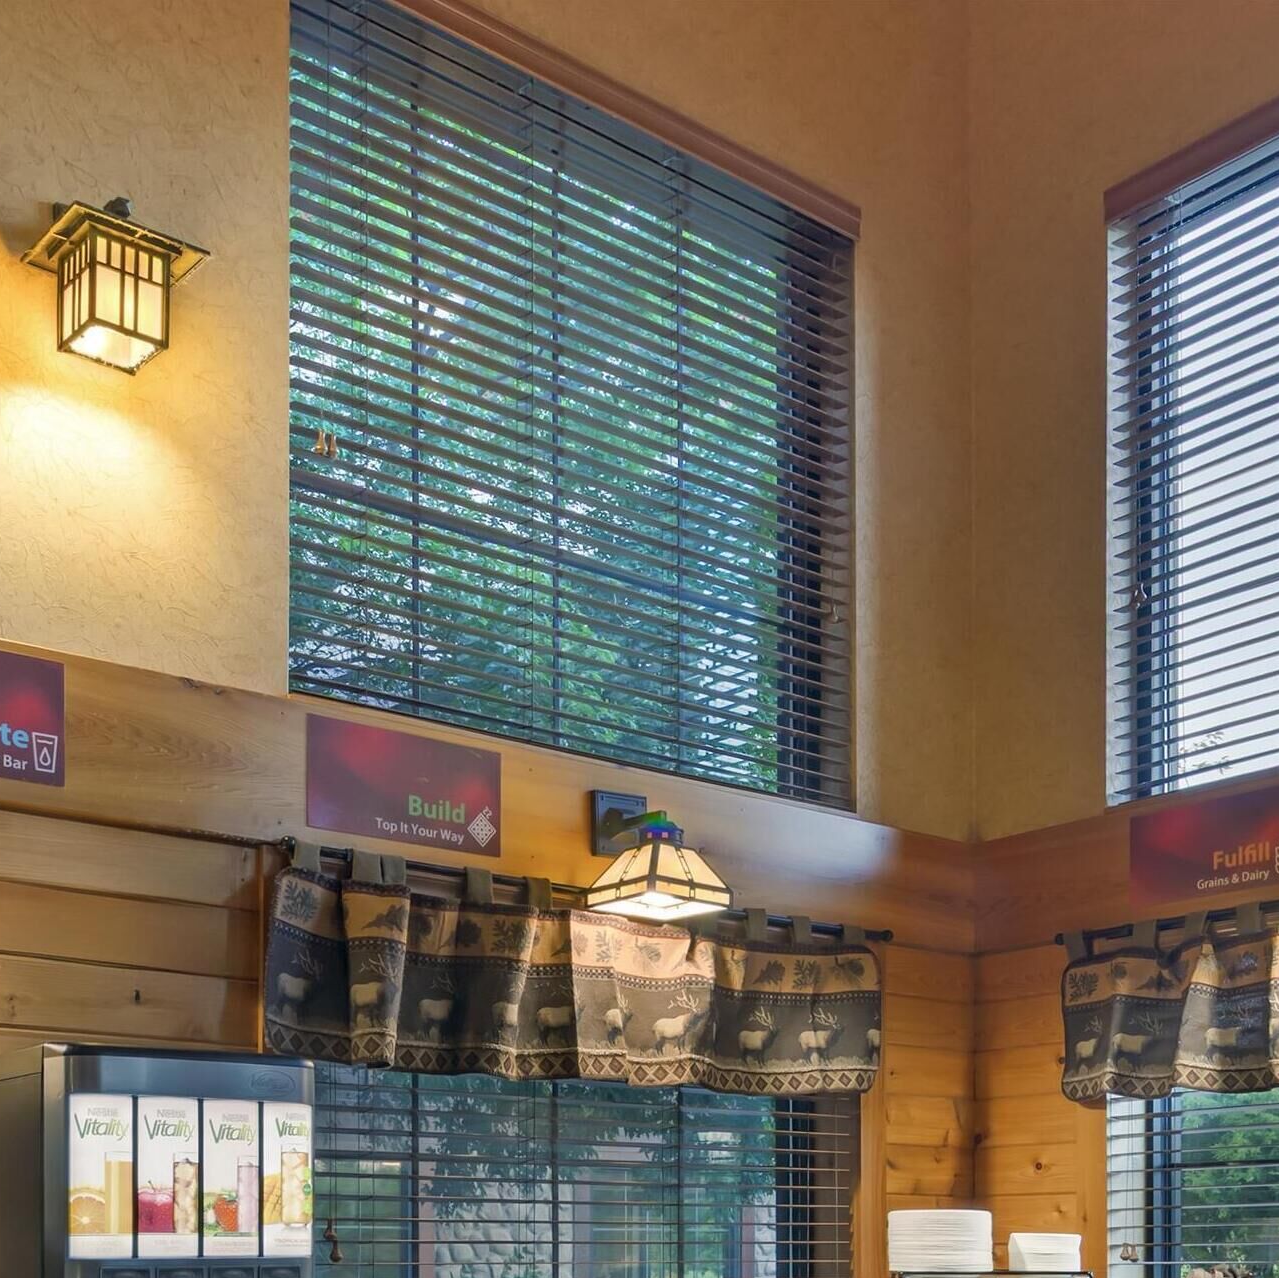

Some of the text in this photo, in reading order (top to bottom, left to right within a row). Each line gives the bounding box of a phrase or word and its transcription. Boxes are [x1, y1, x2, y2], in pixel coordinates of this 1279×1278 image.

[3, 755, 27, 771] Bar
[408, 794, 465, 824] Build
[375, 817, 465, 845] Top It Your Way
[1213, 841, 1270, 870] Fulfill
[1197, 869, 1270, 890] Grains & Dairy
[74, 1113, 130, 1141] Vitality
[144, 1114, 195, 1142] Vitality
[209, 1118, 257, 1146] Vitality
